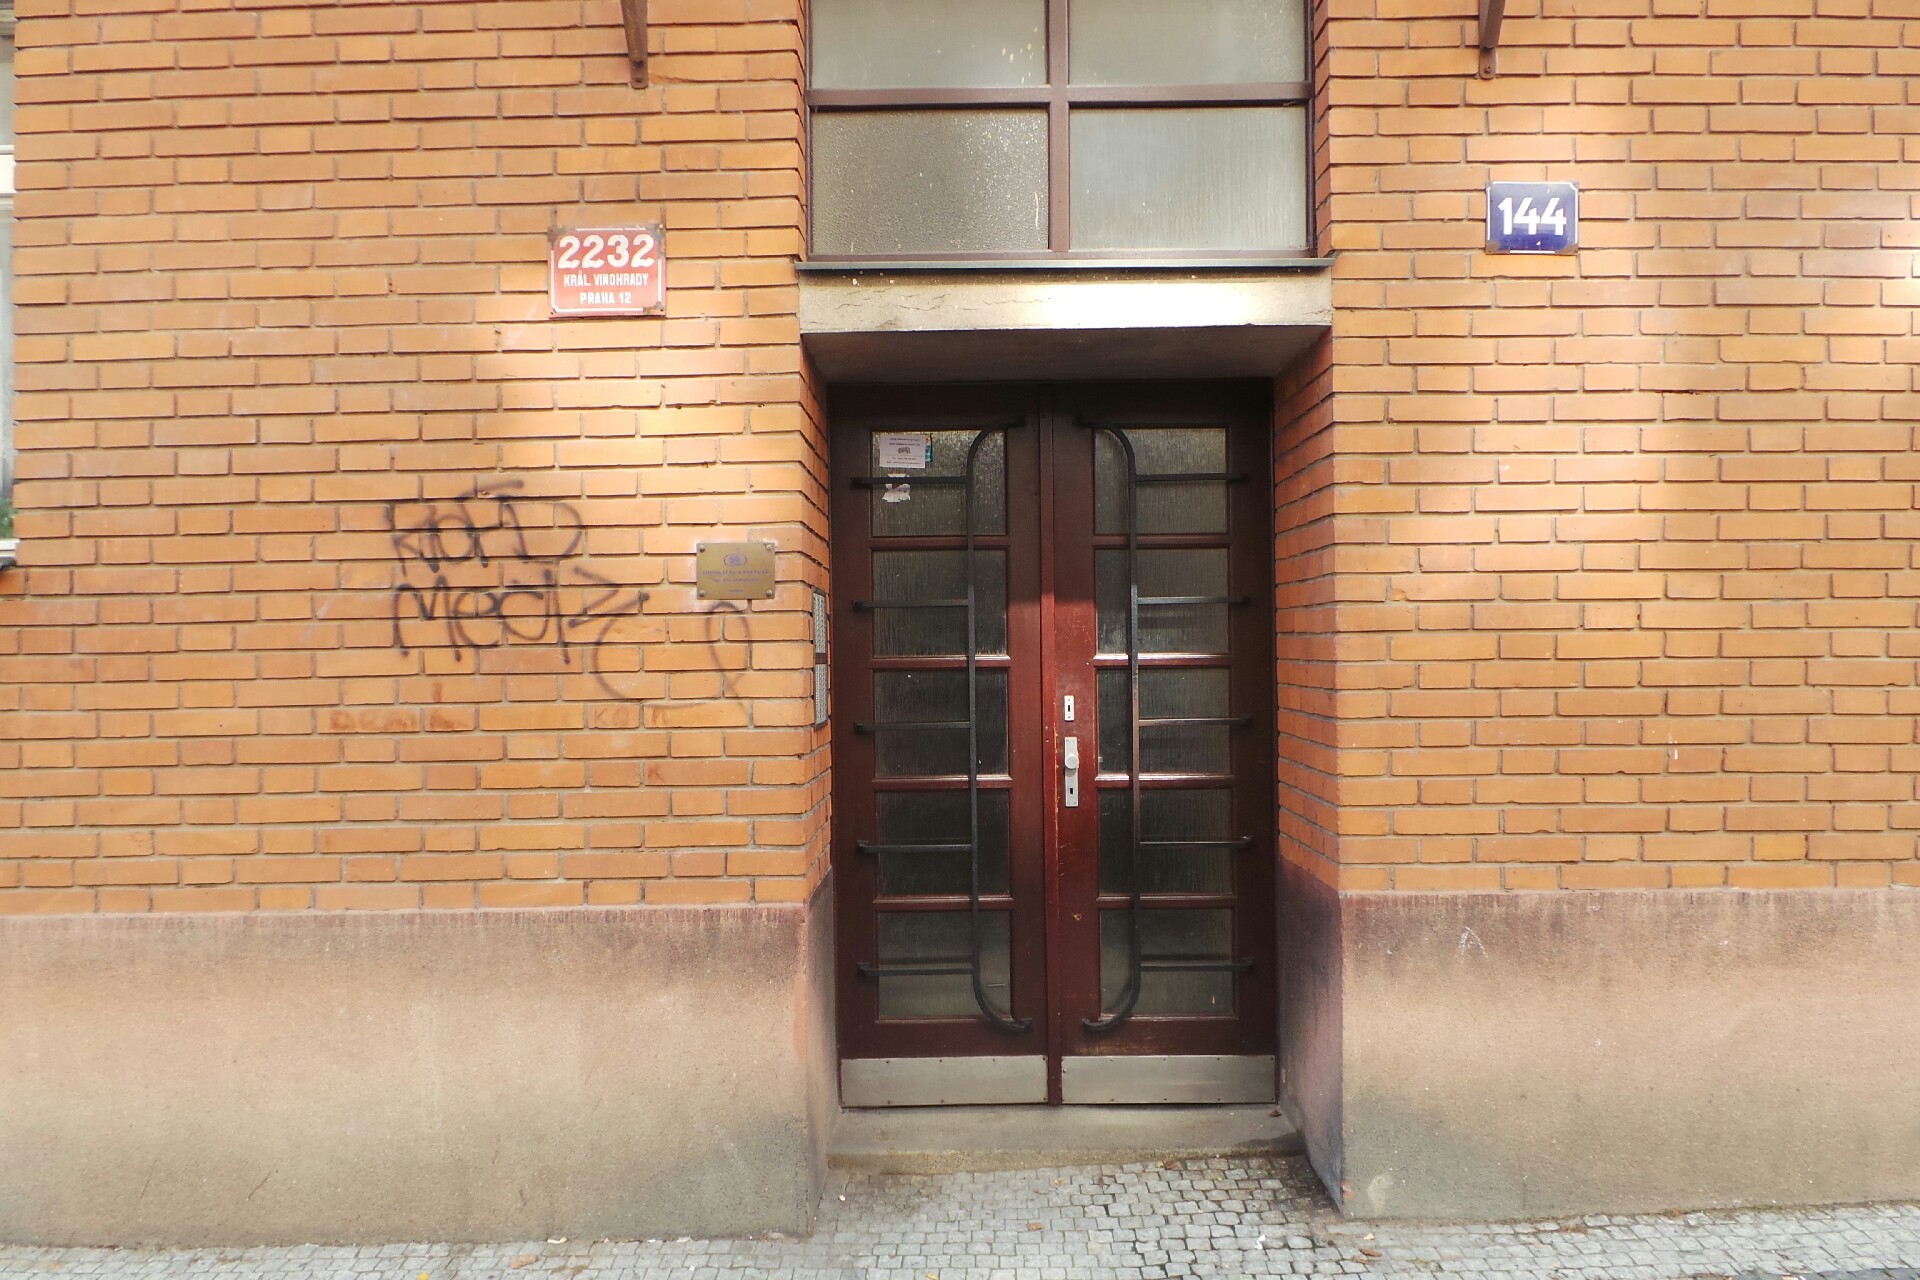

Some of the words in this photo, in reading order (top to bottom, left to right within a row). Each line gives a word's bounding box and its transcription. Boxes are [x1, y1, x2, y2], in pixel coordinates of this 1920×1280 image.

[1497, 197, 1567, 236] 144
[557, 233, 656, 269] 2232
[593, 272, 649, 287] VINOHRADY
[580, 291, 616, 304] PRAHA
[619, 291, 632, 304] 12
